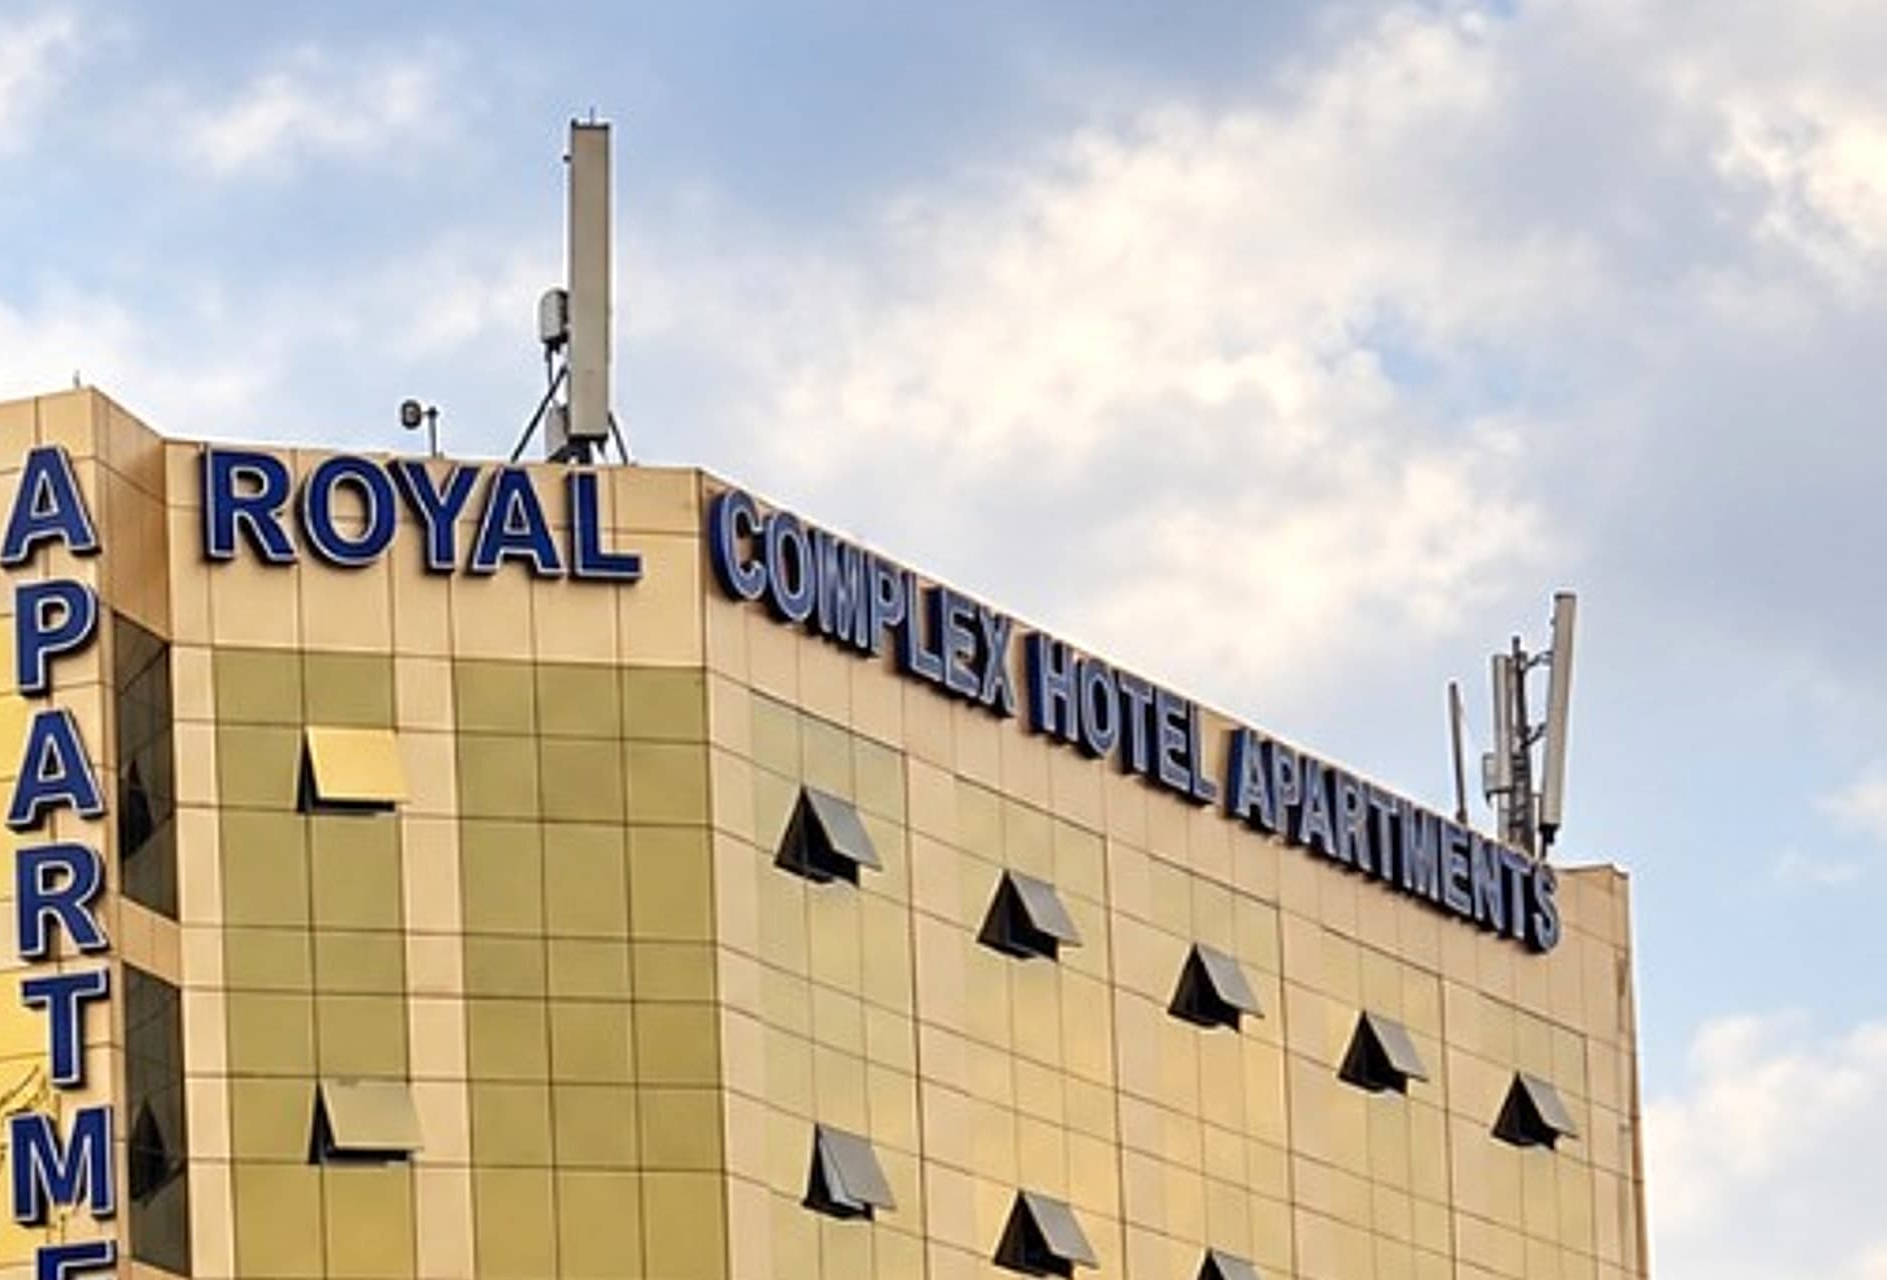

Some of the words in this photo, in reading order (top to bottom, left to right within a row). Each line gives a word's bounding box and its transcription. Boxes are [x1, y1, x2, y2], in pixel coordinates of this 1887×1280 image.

[202, 446, 643, 582] ROYAL
[712, 488, 1016, 718] COMPLEX
[1026, 630, 1216, 806] HOTEL
[1228, 725, 1561, 953] APARTMENTS
